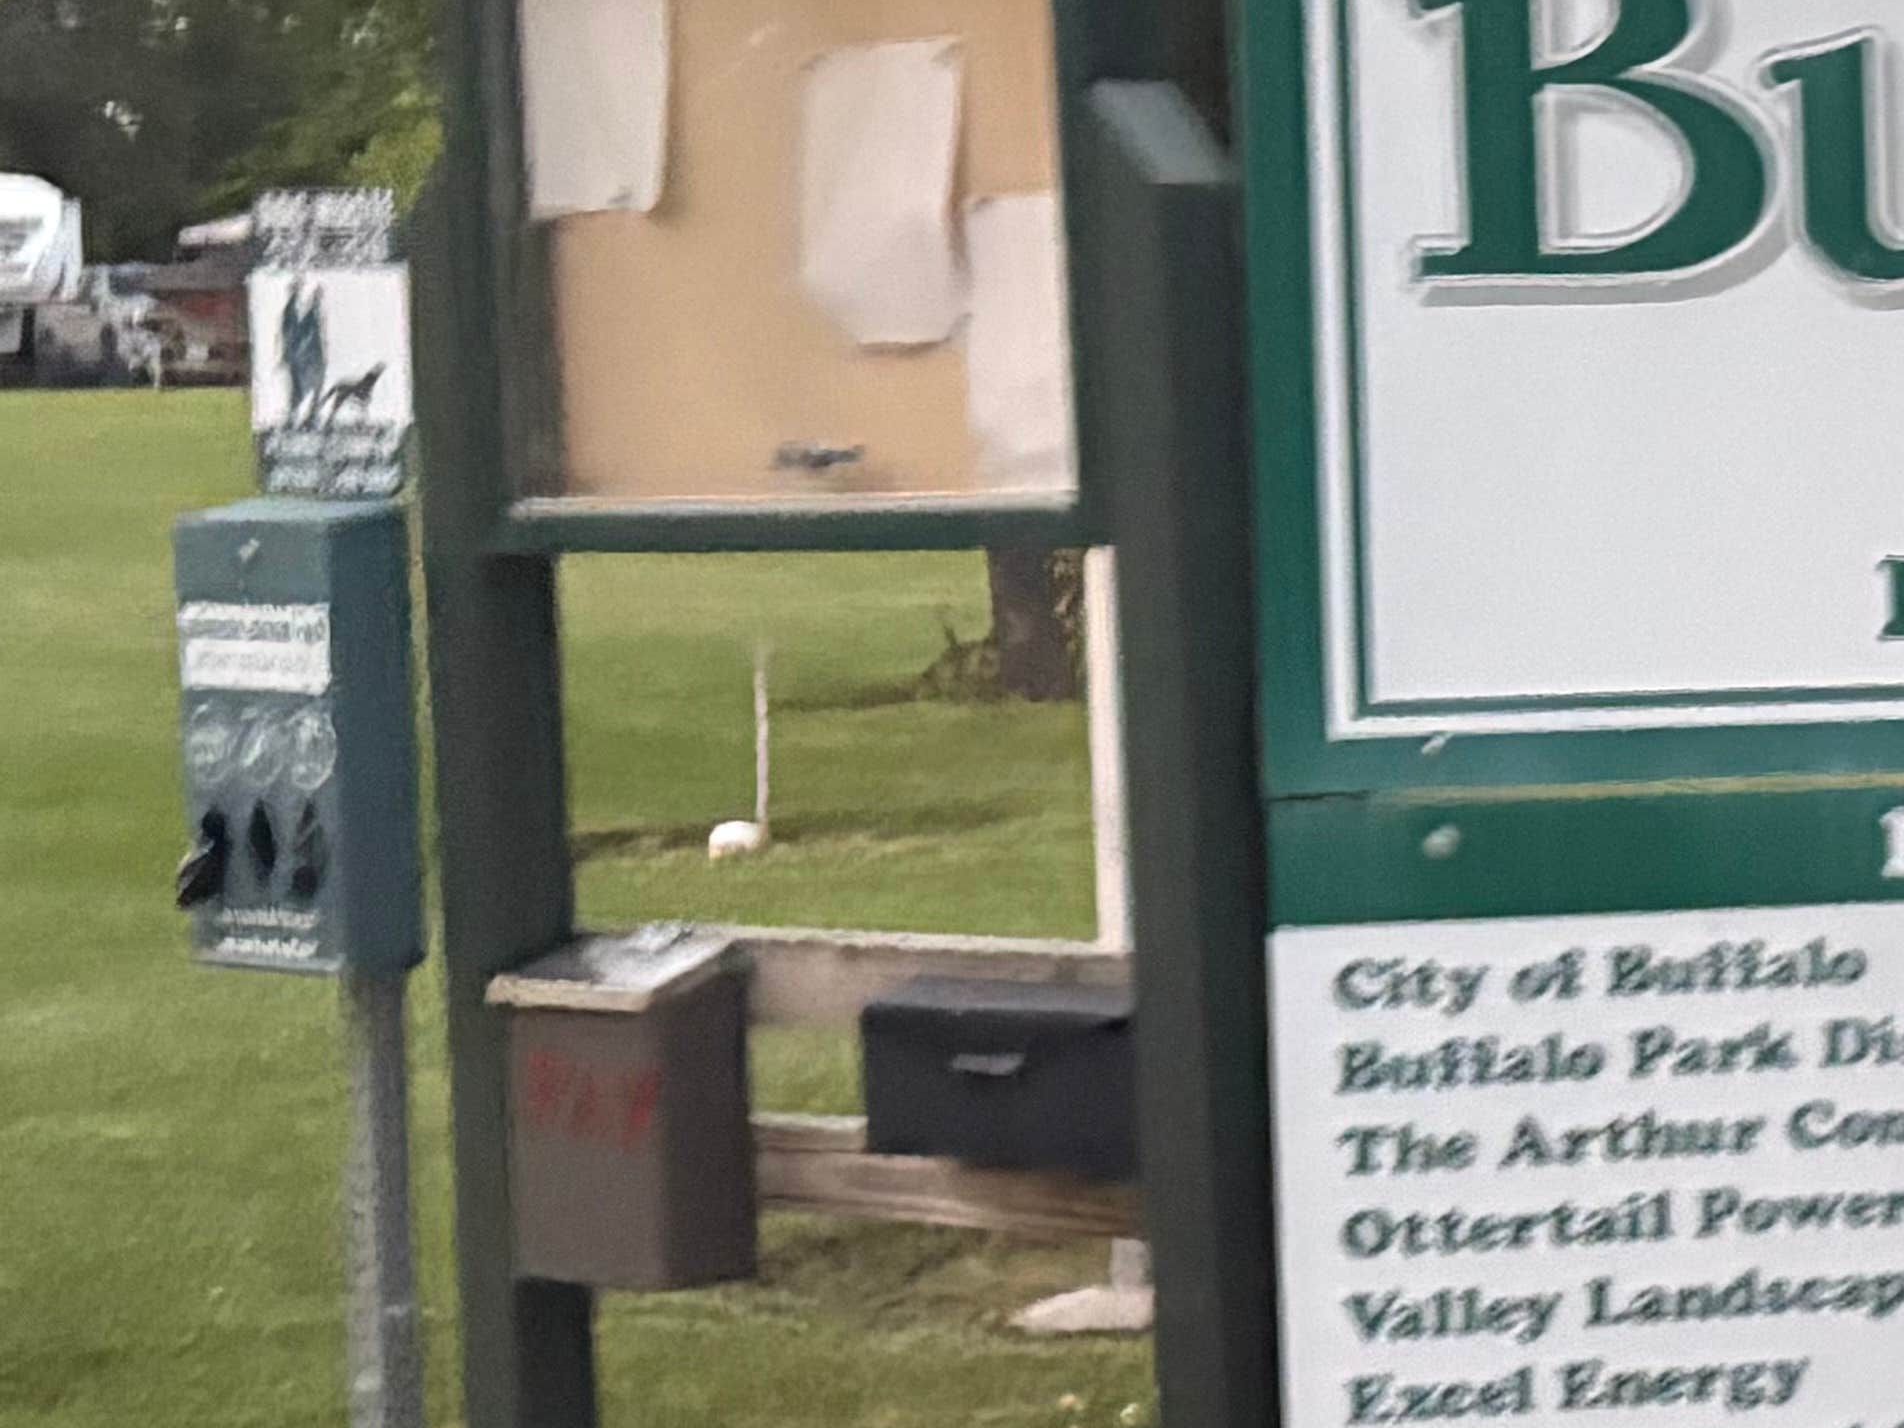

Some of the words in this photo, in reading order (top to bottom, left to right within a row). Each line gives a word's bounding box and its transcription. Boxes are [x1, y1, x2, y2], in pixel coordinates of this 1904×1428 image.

[1334, 955, 1486, 1016] City
[1509, 949, 1583, 1002] of
[1608, 938, 1869, 997] Buffalo
[1334, 1034, 1603, 1095] Buffalo
[1628, 1024, 1795, 1078] Park
[1338, 1122, 1477, 1178] The
[1498, 1108, 1766, 1169] Arthur
[1340, 1191, 1673, 1260] Ottertail
[1342, 1288, 1564, 1345] Valley
[1345, 1366, 1533, 1425] Excel
[1556, 1353, 1809, 1413] Energy
